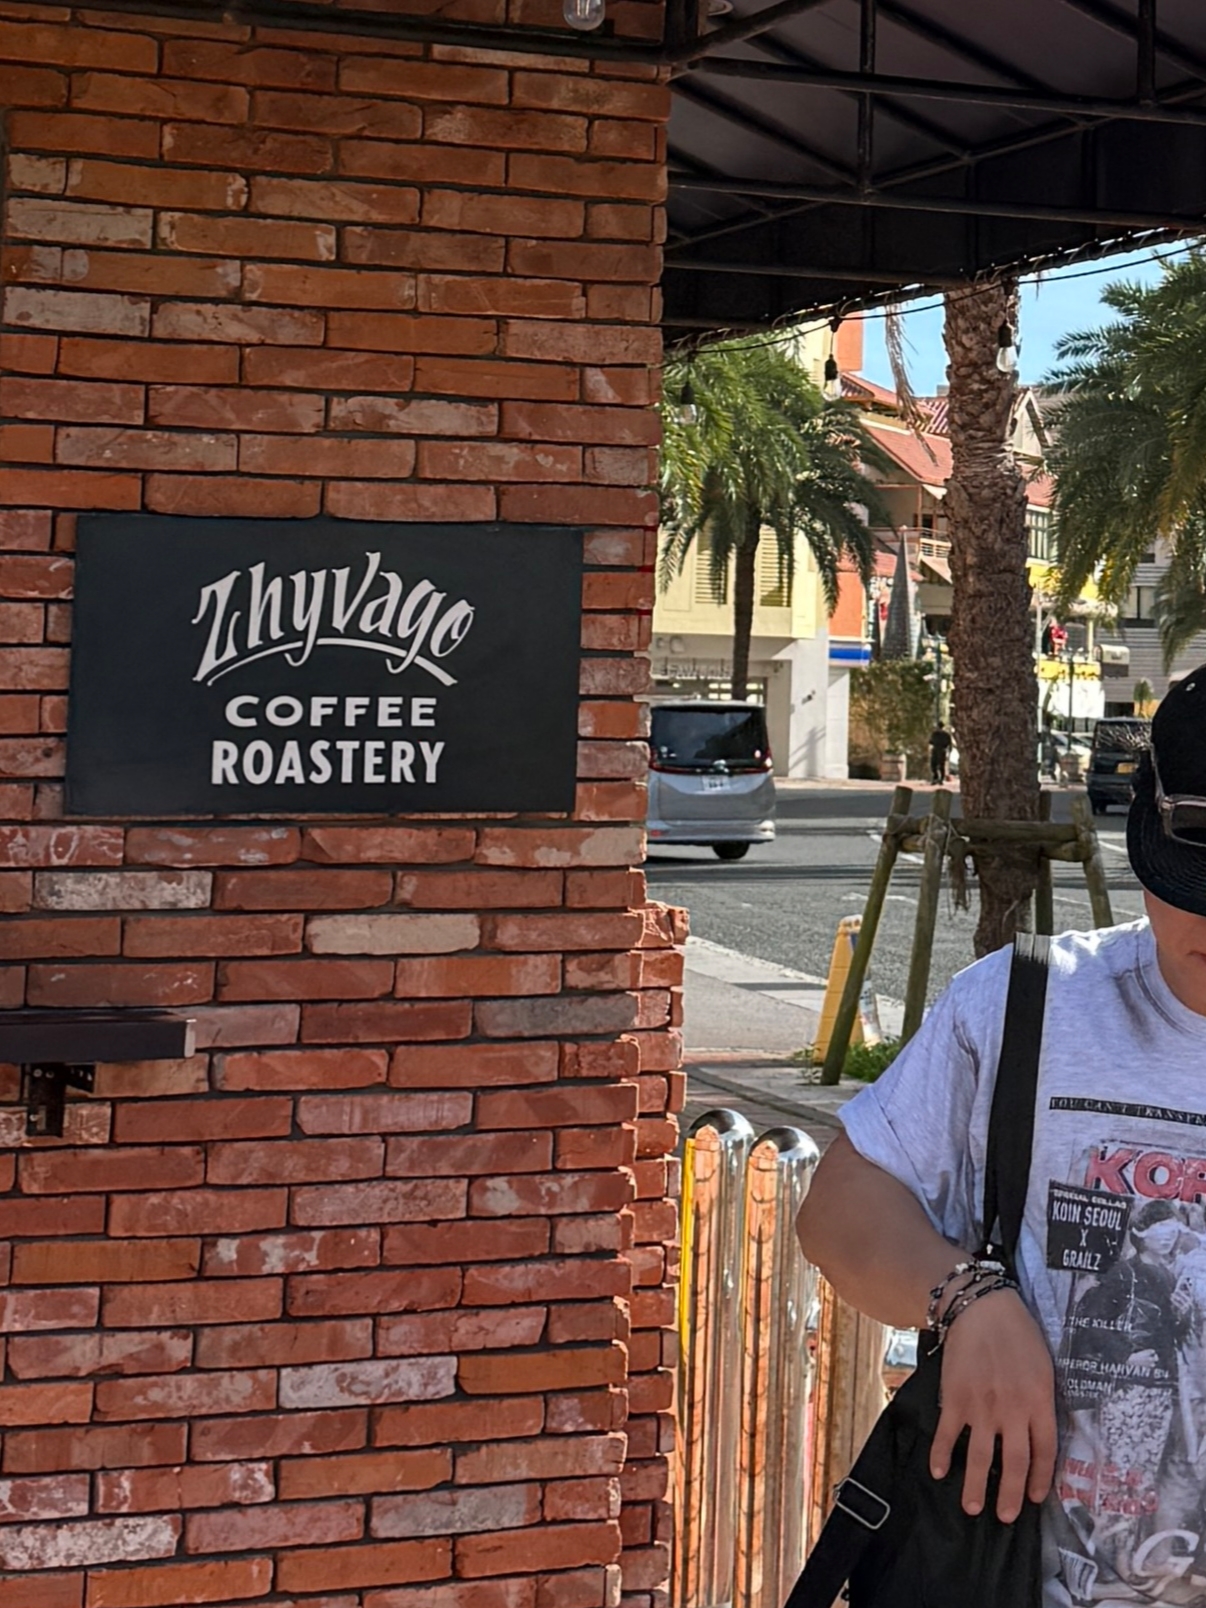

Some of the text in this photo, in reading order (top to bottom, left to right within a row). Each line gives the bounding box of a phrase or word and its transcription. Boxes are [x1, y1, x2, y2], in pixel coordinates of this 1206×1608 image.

[224, 695, 437, 728] COFFEE
[211, 740, 446, 785] ROASTERY
[1084, 1100, 1128, 1114] CANT
[1051, 1200, 1122, 1231] KOIN SEOUL
[1079, 1228, 1089, 1247] X
[1062, 1248, 1102, 1271] GRAILZ
